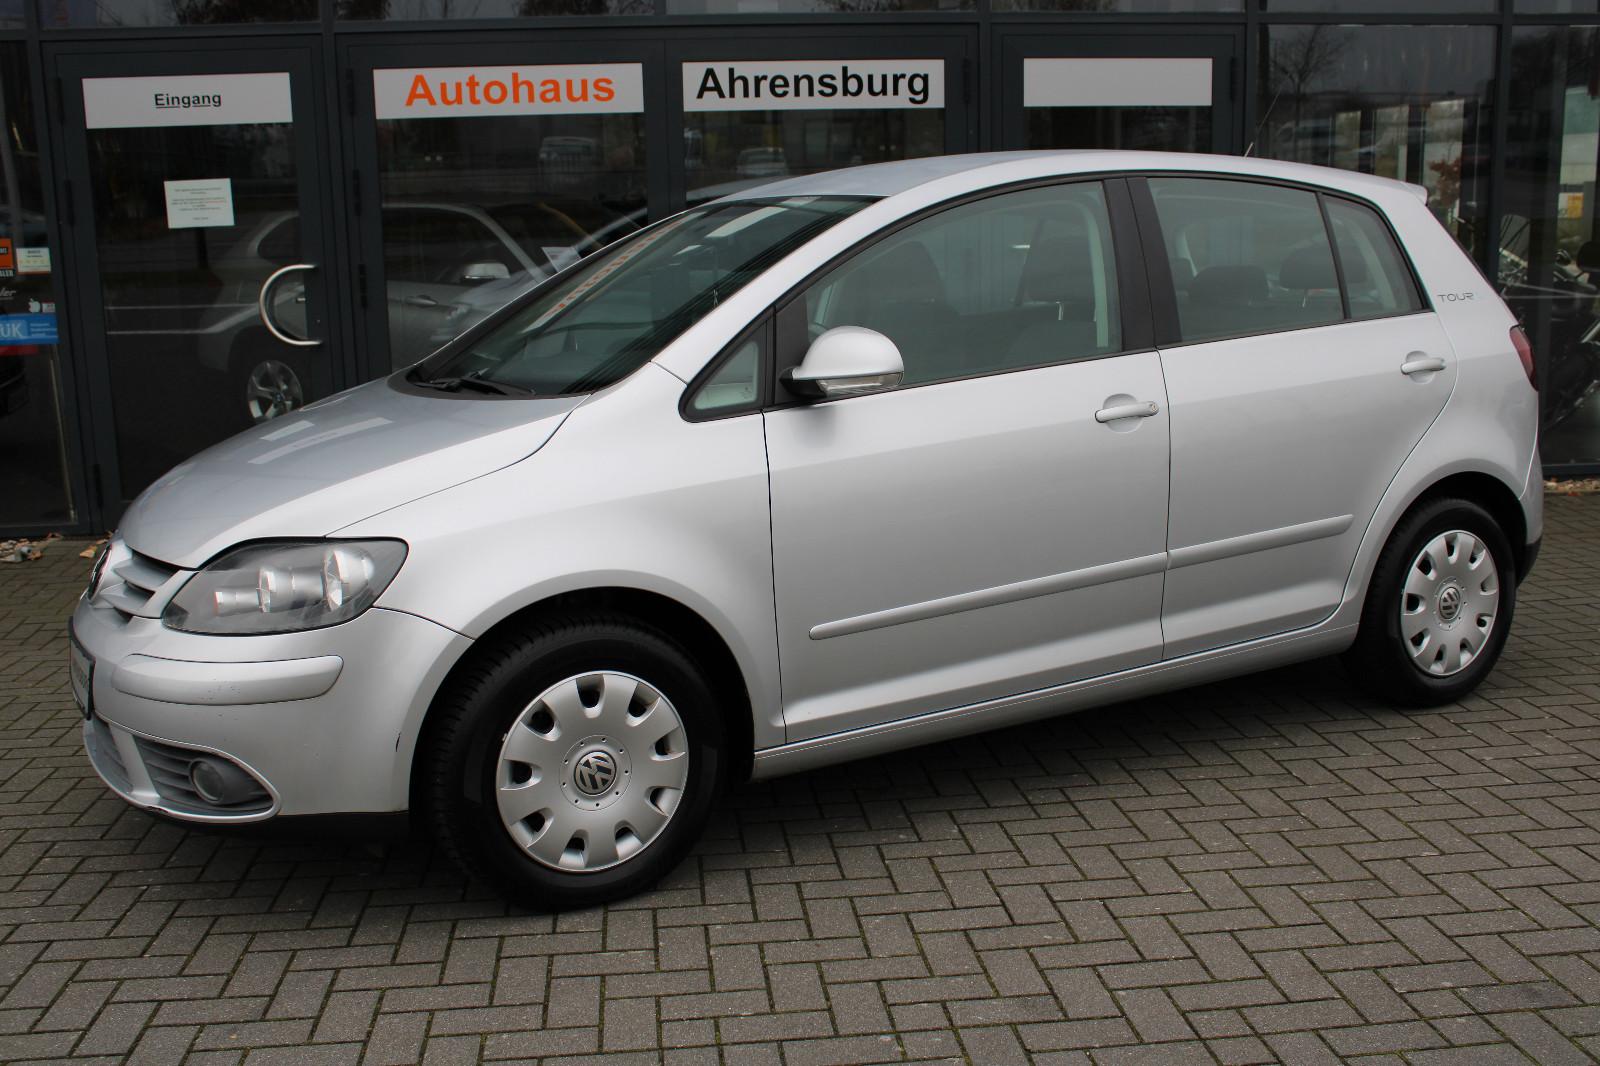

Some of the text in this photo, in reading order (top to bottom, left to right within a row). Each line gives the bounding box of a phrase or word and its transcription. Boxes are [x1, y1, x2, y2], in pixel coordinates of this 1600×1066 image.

[405, 65, 930, 107] Autohaus Ahrensburg
[154, 93, 222, 109] Eingang
[1437, 292, 1474, 303] TOUR
